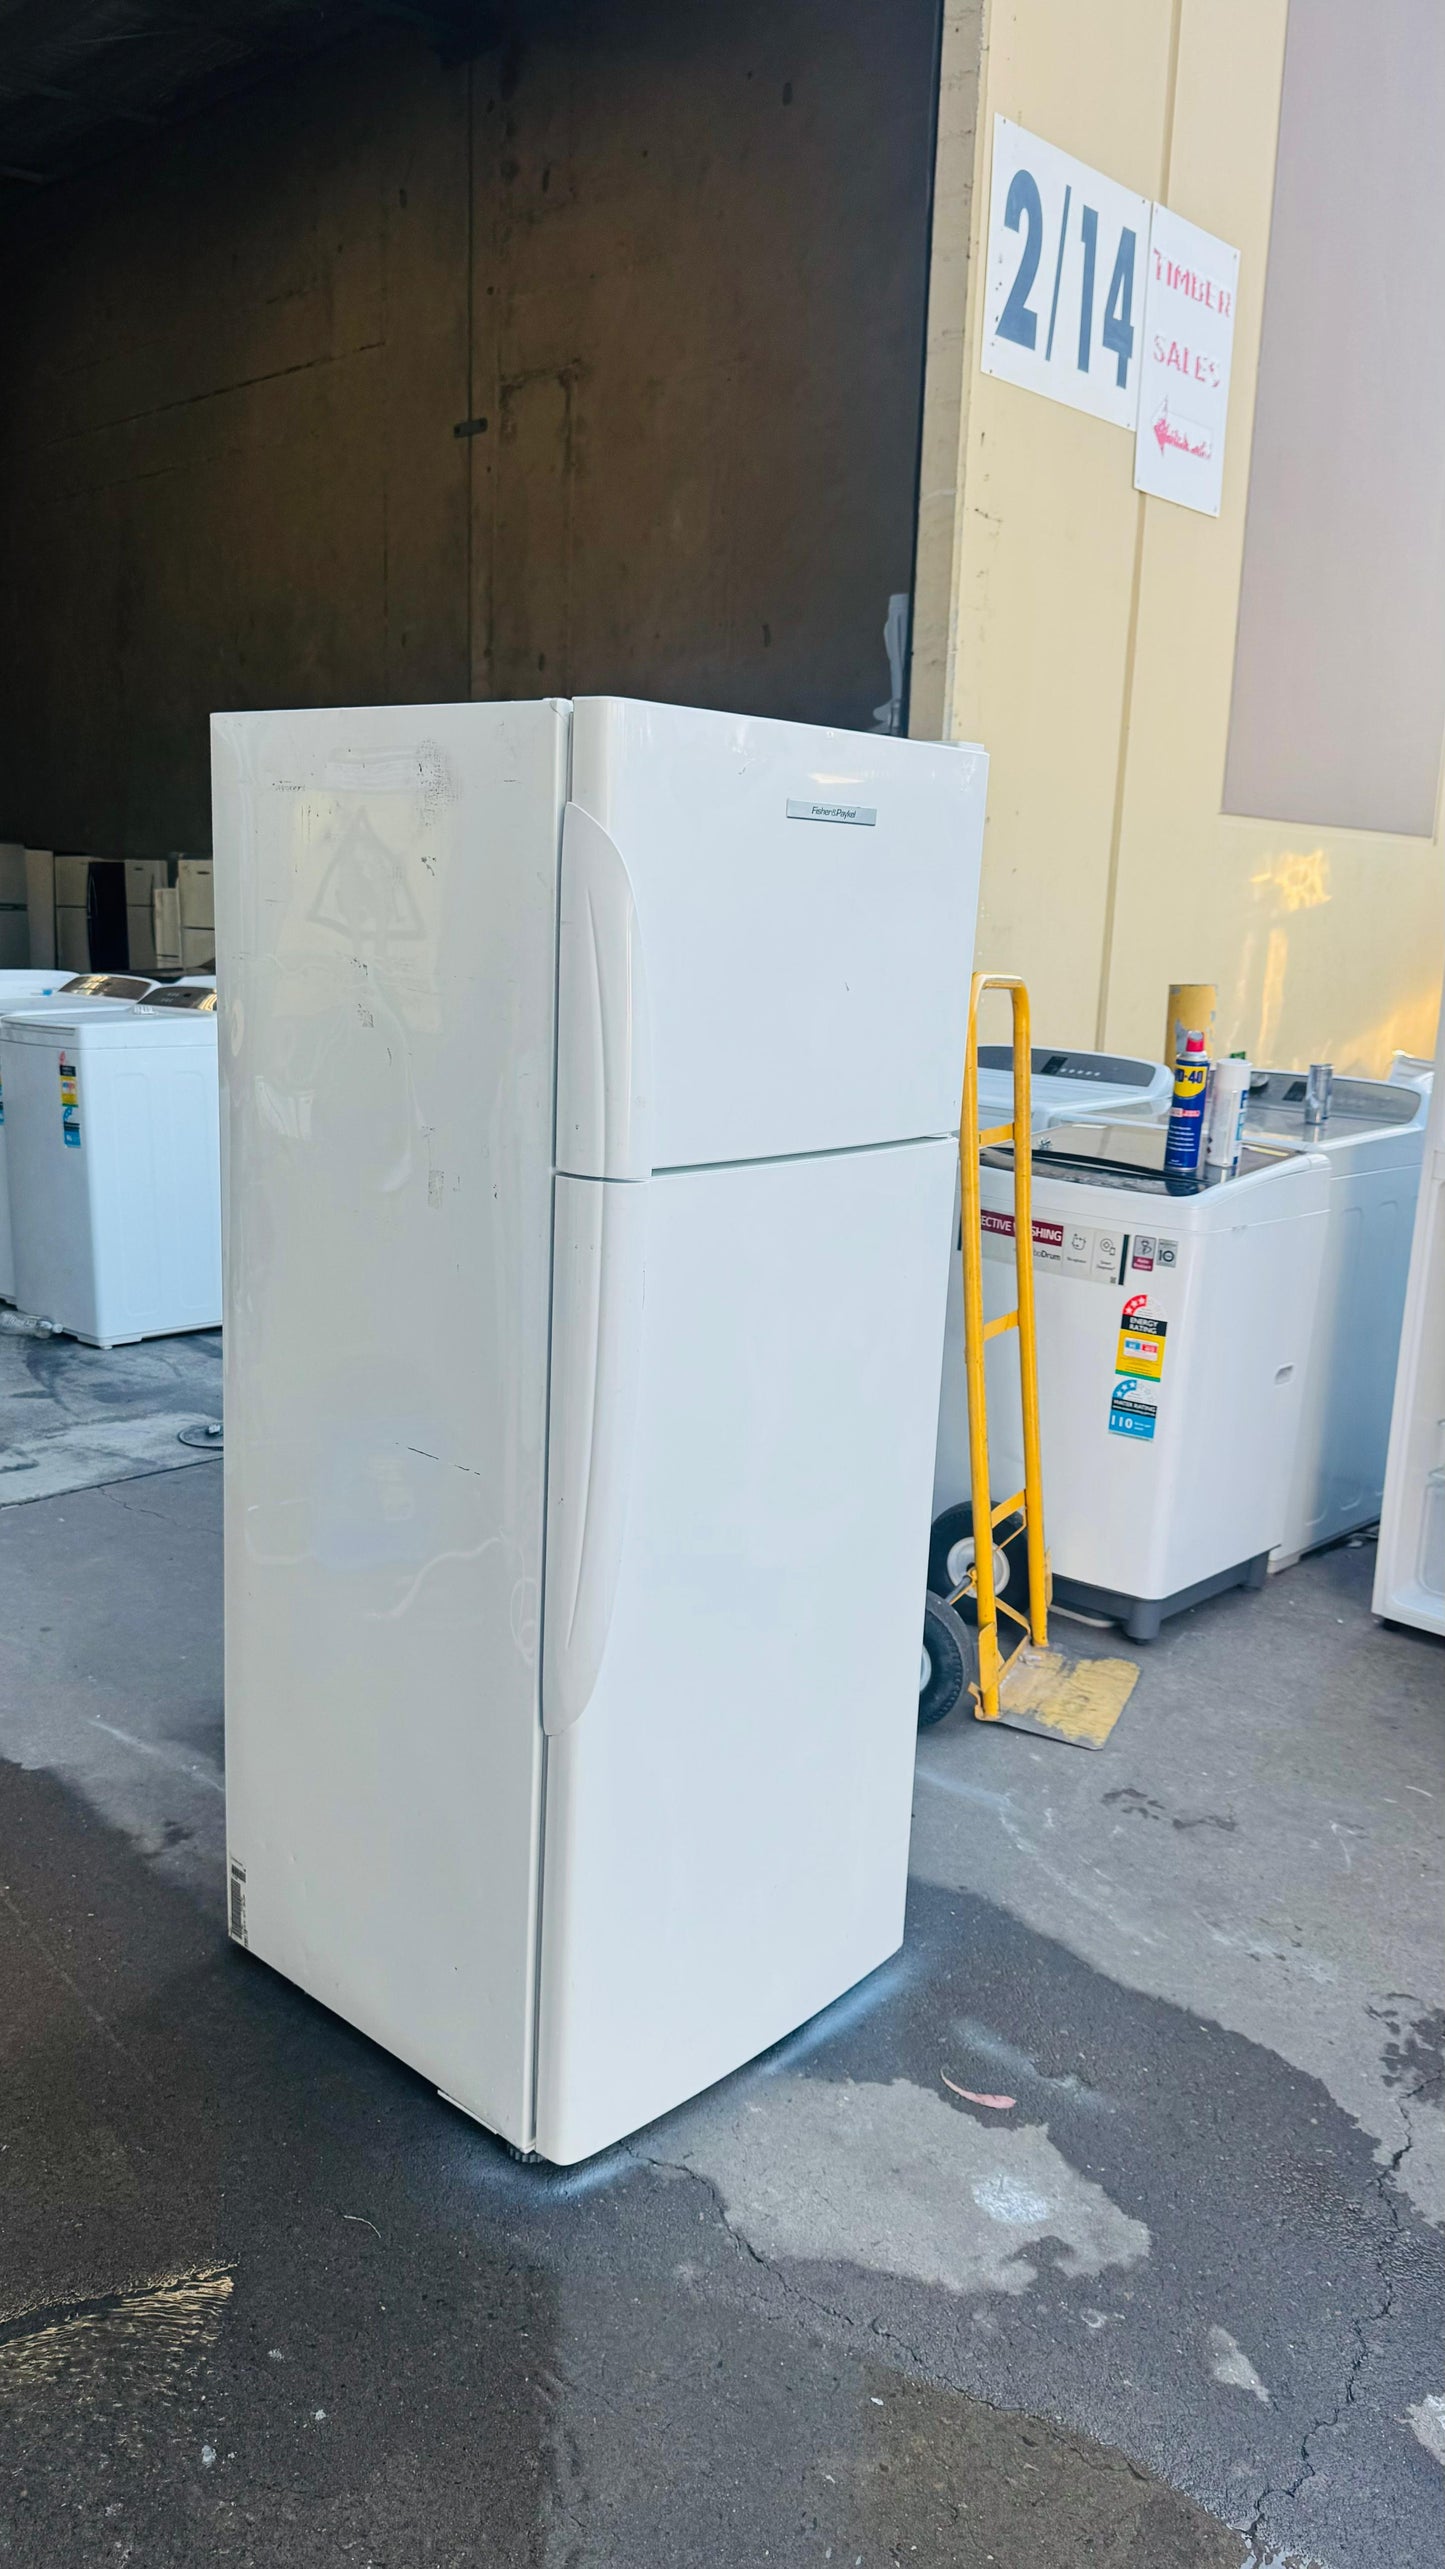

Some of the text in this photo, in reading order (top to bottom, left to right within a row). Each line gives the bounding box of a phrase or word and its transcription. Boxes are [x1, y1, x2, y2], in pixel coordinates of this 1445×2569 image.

[994, 169, 1137, 390] 2/14
[1153, 247, 1231, 318] TIMBER
[1153, 334, 1221, 388] SALES
[980, 1215, 1062, 1242] ECTIVE SHING
[1111, 1415, 1134, 1429] 110
